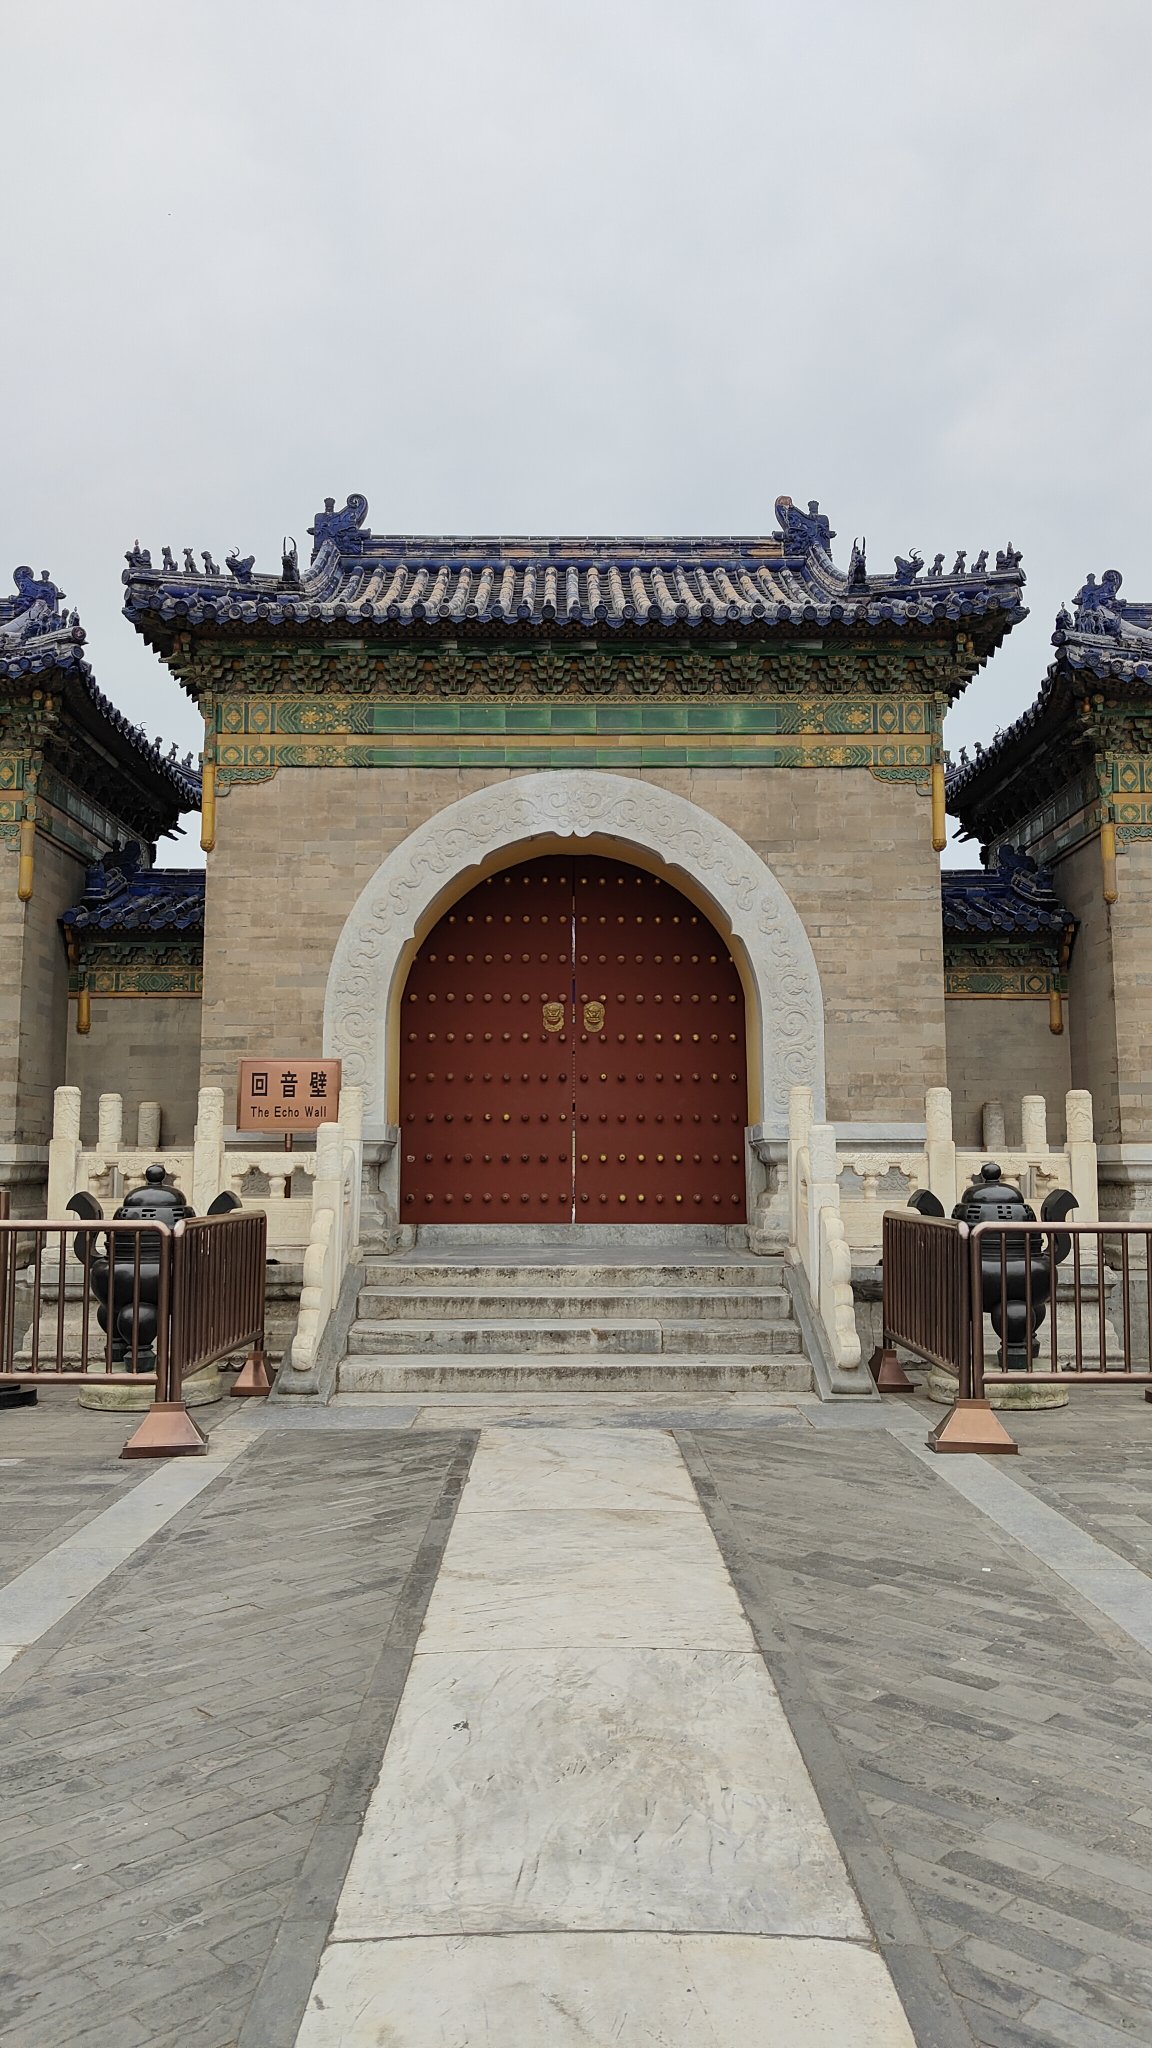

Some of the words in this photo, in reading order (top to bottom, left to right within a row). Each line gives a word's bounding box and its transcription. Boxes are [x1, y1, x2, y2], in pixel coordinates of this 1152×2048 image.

[251, 1070, 327, 1098] 回音壁
[250, 1105, 270, 1118] The
[274, 1105, 300, 1118] Echo
[304, 1105, 327, 1118] Wall
